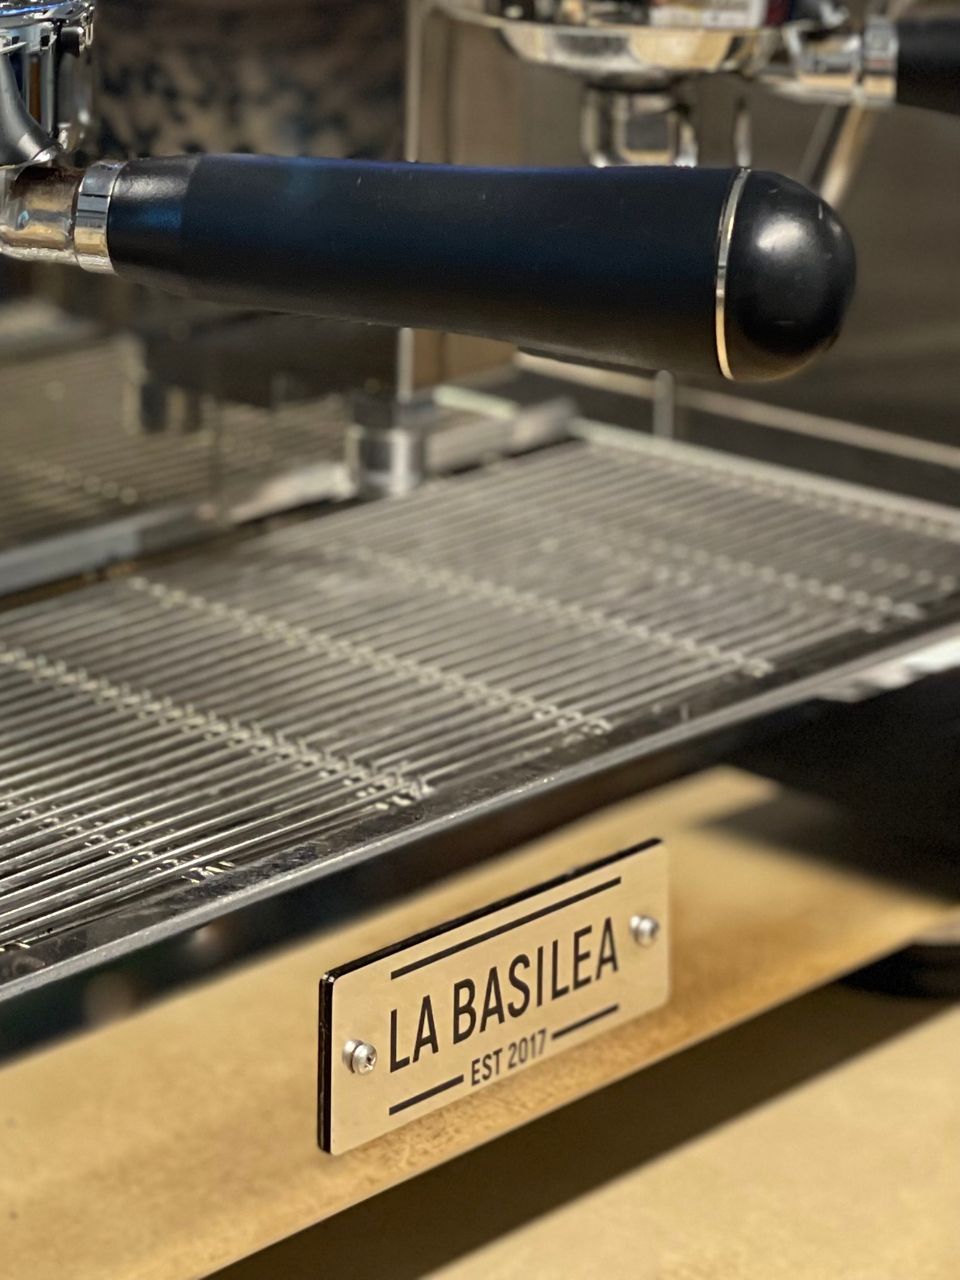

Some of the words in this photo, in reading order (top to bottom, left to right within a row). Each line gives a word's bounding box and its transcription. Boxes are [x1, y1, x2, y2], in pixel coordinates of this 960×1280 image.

[390, 994, 439, 1073] LA
[453, 917, 619, 1045] BASILEA
[471, 1048, 503, 1087] EST
[508, 1028, 547, 1070] 2017
